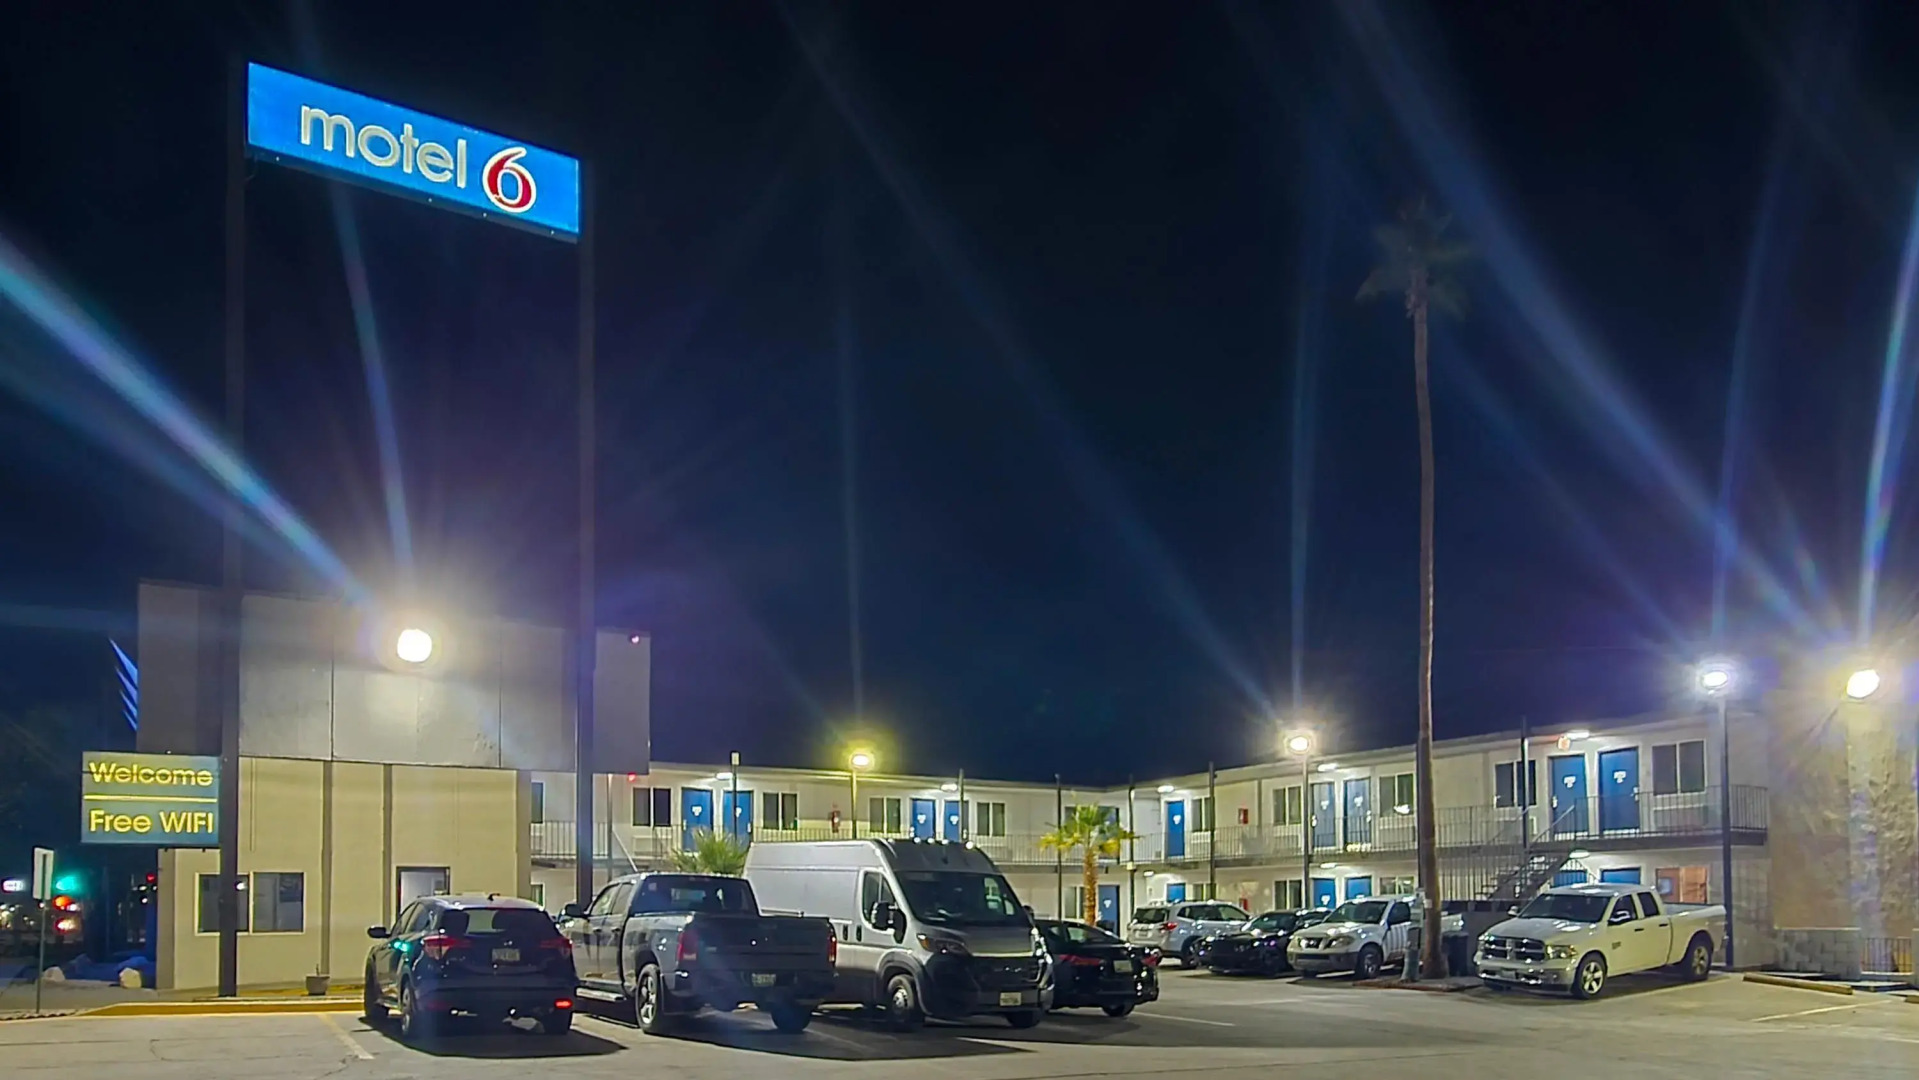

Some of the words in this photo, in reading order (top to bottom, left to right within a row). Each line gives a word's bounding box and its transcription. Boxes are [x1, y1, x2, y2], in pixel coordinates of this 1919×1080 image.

[301, 105, 467, 188] motel
[482, 147, 536, 213] 6
[89, 761, 213, 786] Welcome
[89, 810, 152, 833] Free
[159, 811, 214, 834] WIFI
